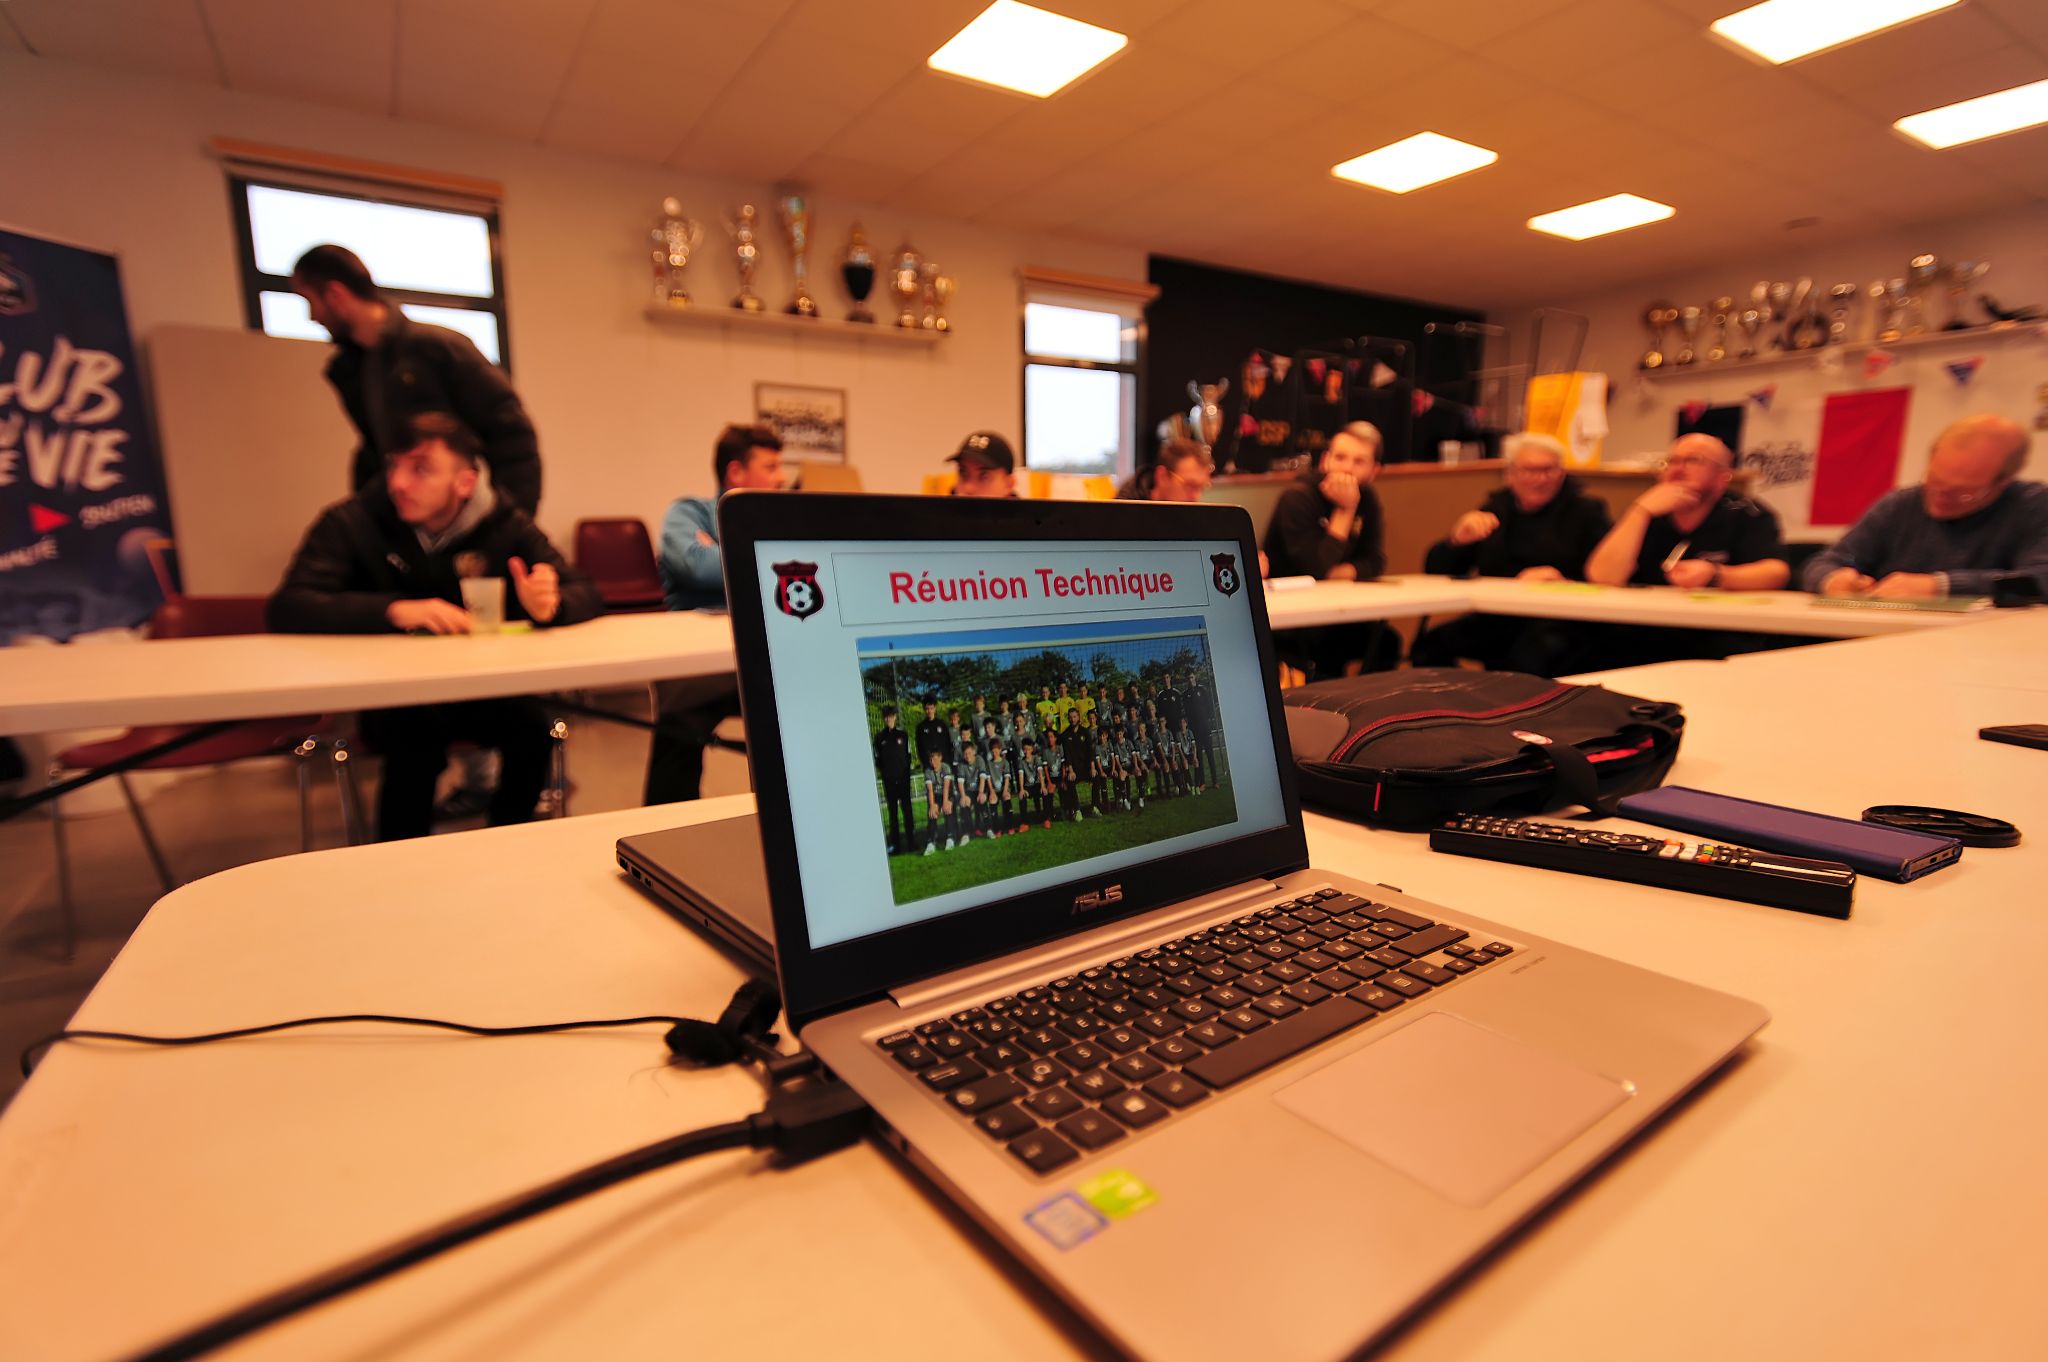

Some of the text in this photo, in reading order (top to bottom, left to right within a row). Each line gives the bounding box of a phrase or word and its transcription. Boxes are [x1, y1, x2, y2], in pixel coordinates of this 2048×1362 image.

[0, 335, 124, 425] UB
[25, 421, 129, 492] VIE
[889, 567, 1174, 604] Réunion Technique
[1072, 884, 1123, 915] ASUS
